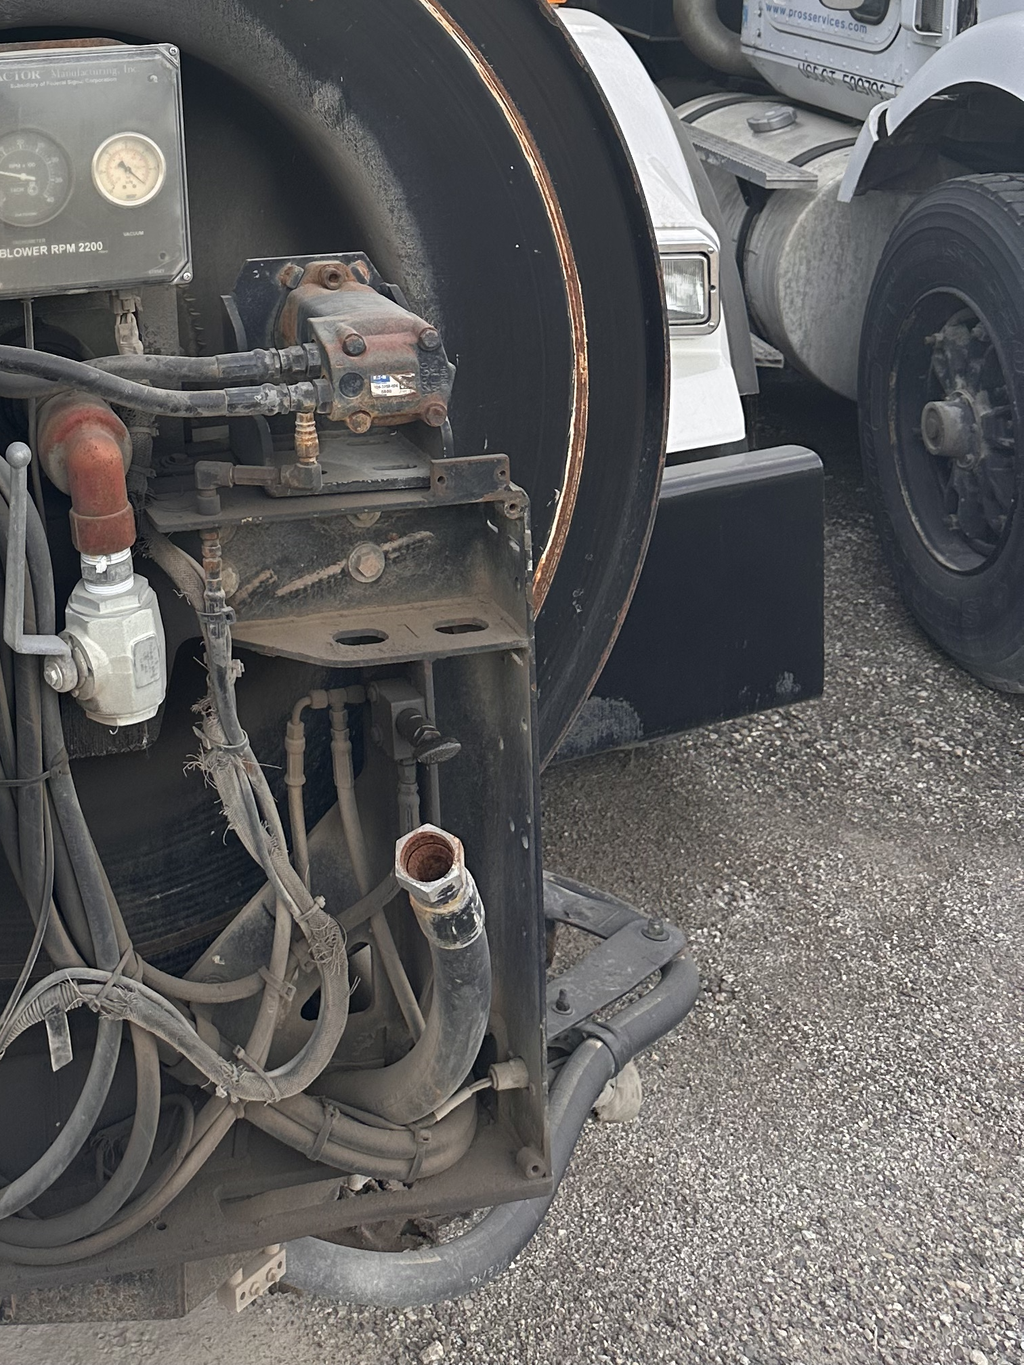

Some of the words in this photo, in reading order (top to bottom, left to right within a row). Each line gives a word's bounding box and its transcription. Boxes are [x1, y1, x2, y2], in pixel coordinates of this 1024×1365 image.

[765, 3, 868, 34] www.prosservices.com
[0, 244, 48, 259] BLOWER
[51, 243, 76, 254] RPM
[78, 241, 103, 253] 2200
